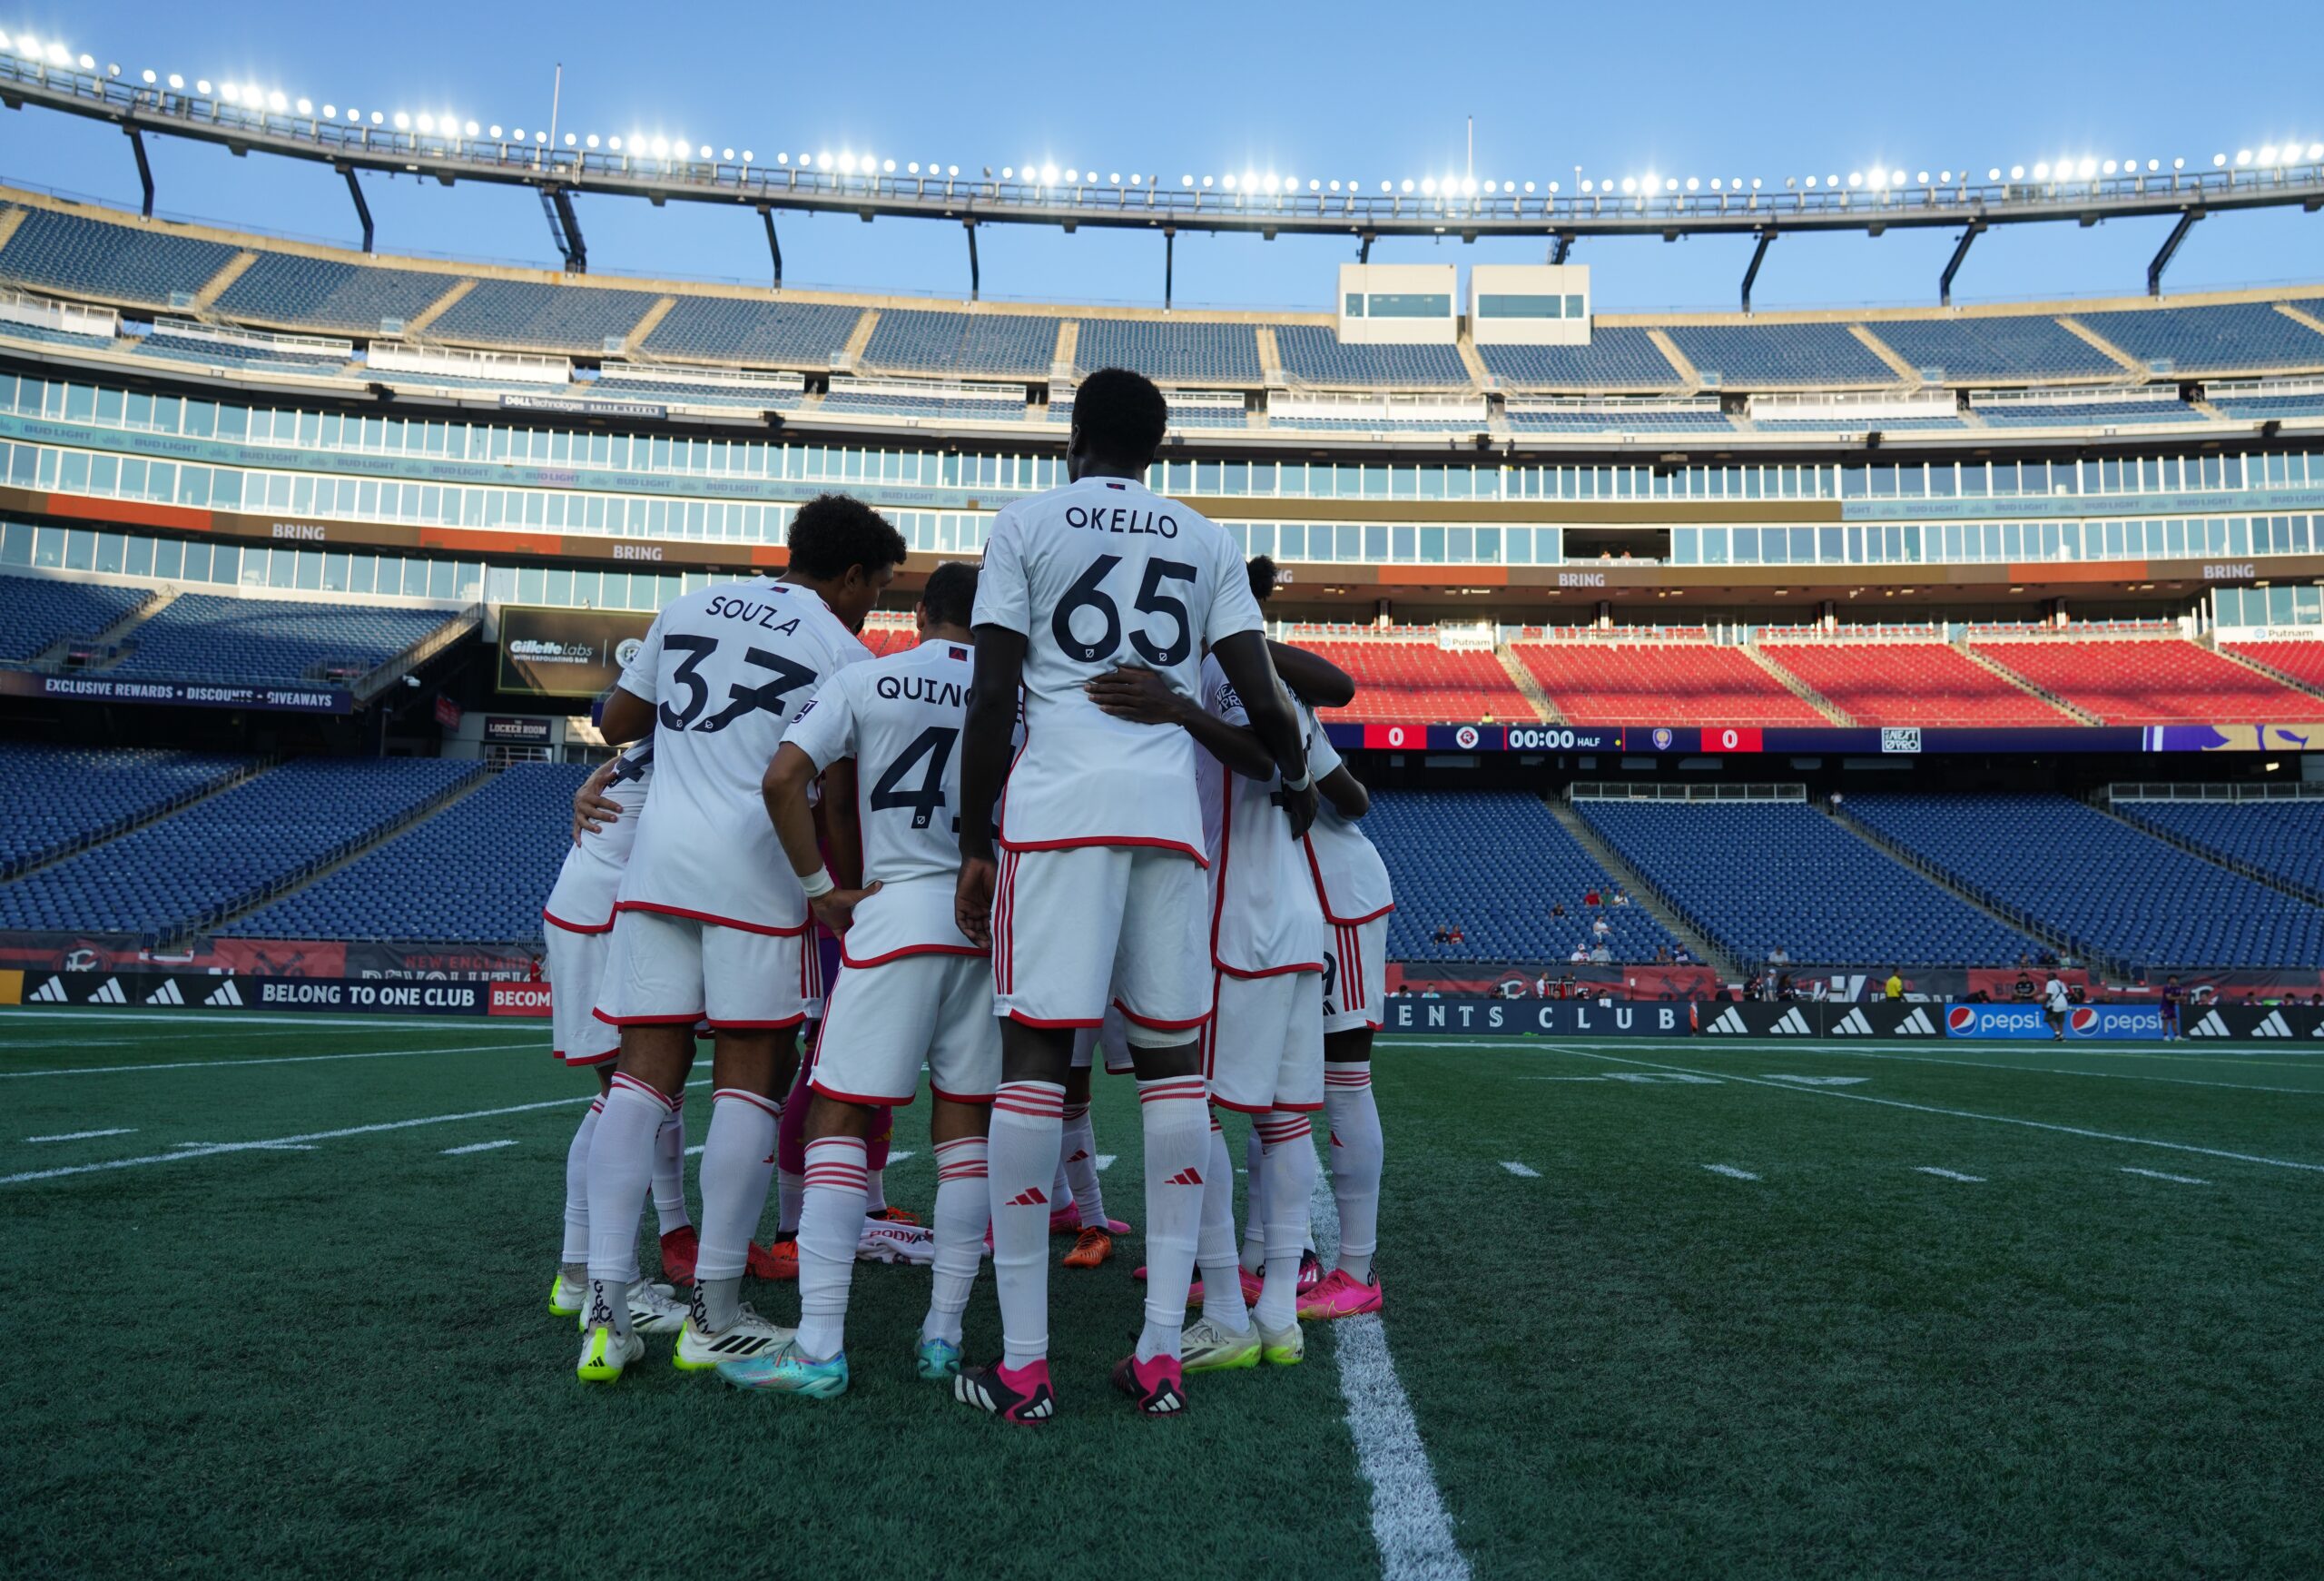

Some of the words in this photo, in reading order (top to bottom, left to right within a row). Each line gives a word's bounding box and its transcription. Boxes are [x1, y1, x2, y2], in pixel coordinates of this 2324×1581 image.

[24, 424, 53, 436] BUD
[54, 429, 91, 440] LIGHT
[134, 438, 161, 449] BUD
[162, 443, 198, 453] LIGHT
[240, 450, 264, 459] BUD
[266, 453, 299, 463] LIGHT
[337, 458, 361, 467] BUD
[363, 460, 395, 470] LIGHT
[432, 465, 456, 474] BUD
[458, 468, 489, 477] LIGHT
[525, 472, 548, 480] BUD
[549, 473, 581, 482] LIGHT
[616, 478, 639, 486] BUD
[640, 479, 672, 488] LIGHT
[881, 491, 902, 499] BUD
[903, 492, 935, 500] LIGHT
[1065, 506, 1178, 539] OKELLO
[272, 523, 325, 541] BRING
[613, 545, 663, 561] BRING
[2203, 564, 2256, 579] BRING
[1559, 573, 1605, 588] BRING
[705, 596, 801, 637] SOUZA
[1051, 554, 1198, 667] 65
[2269, 629, 2314, 637] Putnam
[658, 634, 818, 734] 37
[45, 678, 112, 696] EXCLUSIVE
[115, 683, 173, 699] REWARDS
[267, 691, 332, 707] GIVEAWAYS
[488, 723, 522, 734] LOCKER
[523, 726, 547, 735] ROOM
[1388, 727, 1404, 746] 0
[1509, 730, 1575, 748] 00:00
[1577, 737, 1600, 747] HALF
[1722, 729, 1738, 749] 0
[405, 956, 444, 968] NEW
[448, 956, 529, 969] ENGLAND
[262, 983, 341, 1003] BELONG
[349, 986, 376, 1004] TO
[379, 987, 420, 1005] ONE
[424, 987, 476, 1007] CLUB
[493, 991, 553, 1007] BECOM
[1538, 1006, 1677, 1030] CLUB
[1981, 1011, 2040, 1033] pepsi
[2104, 1013, 2163, 1033] pepsi
